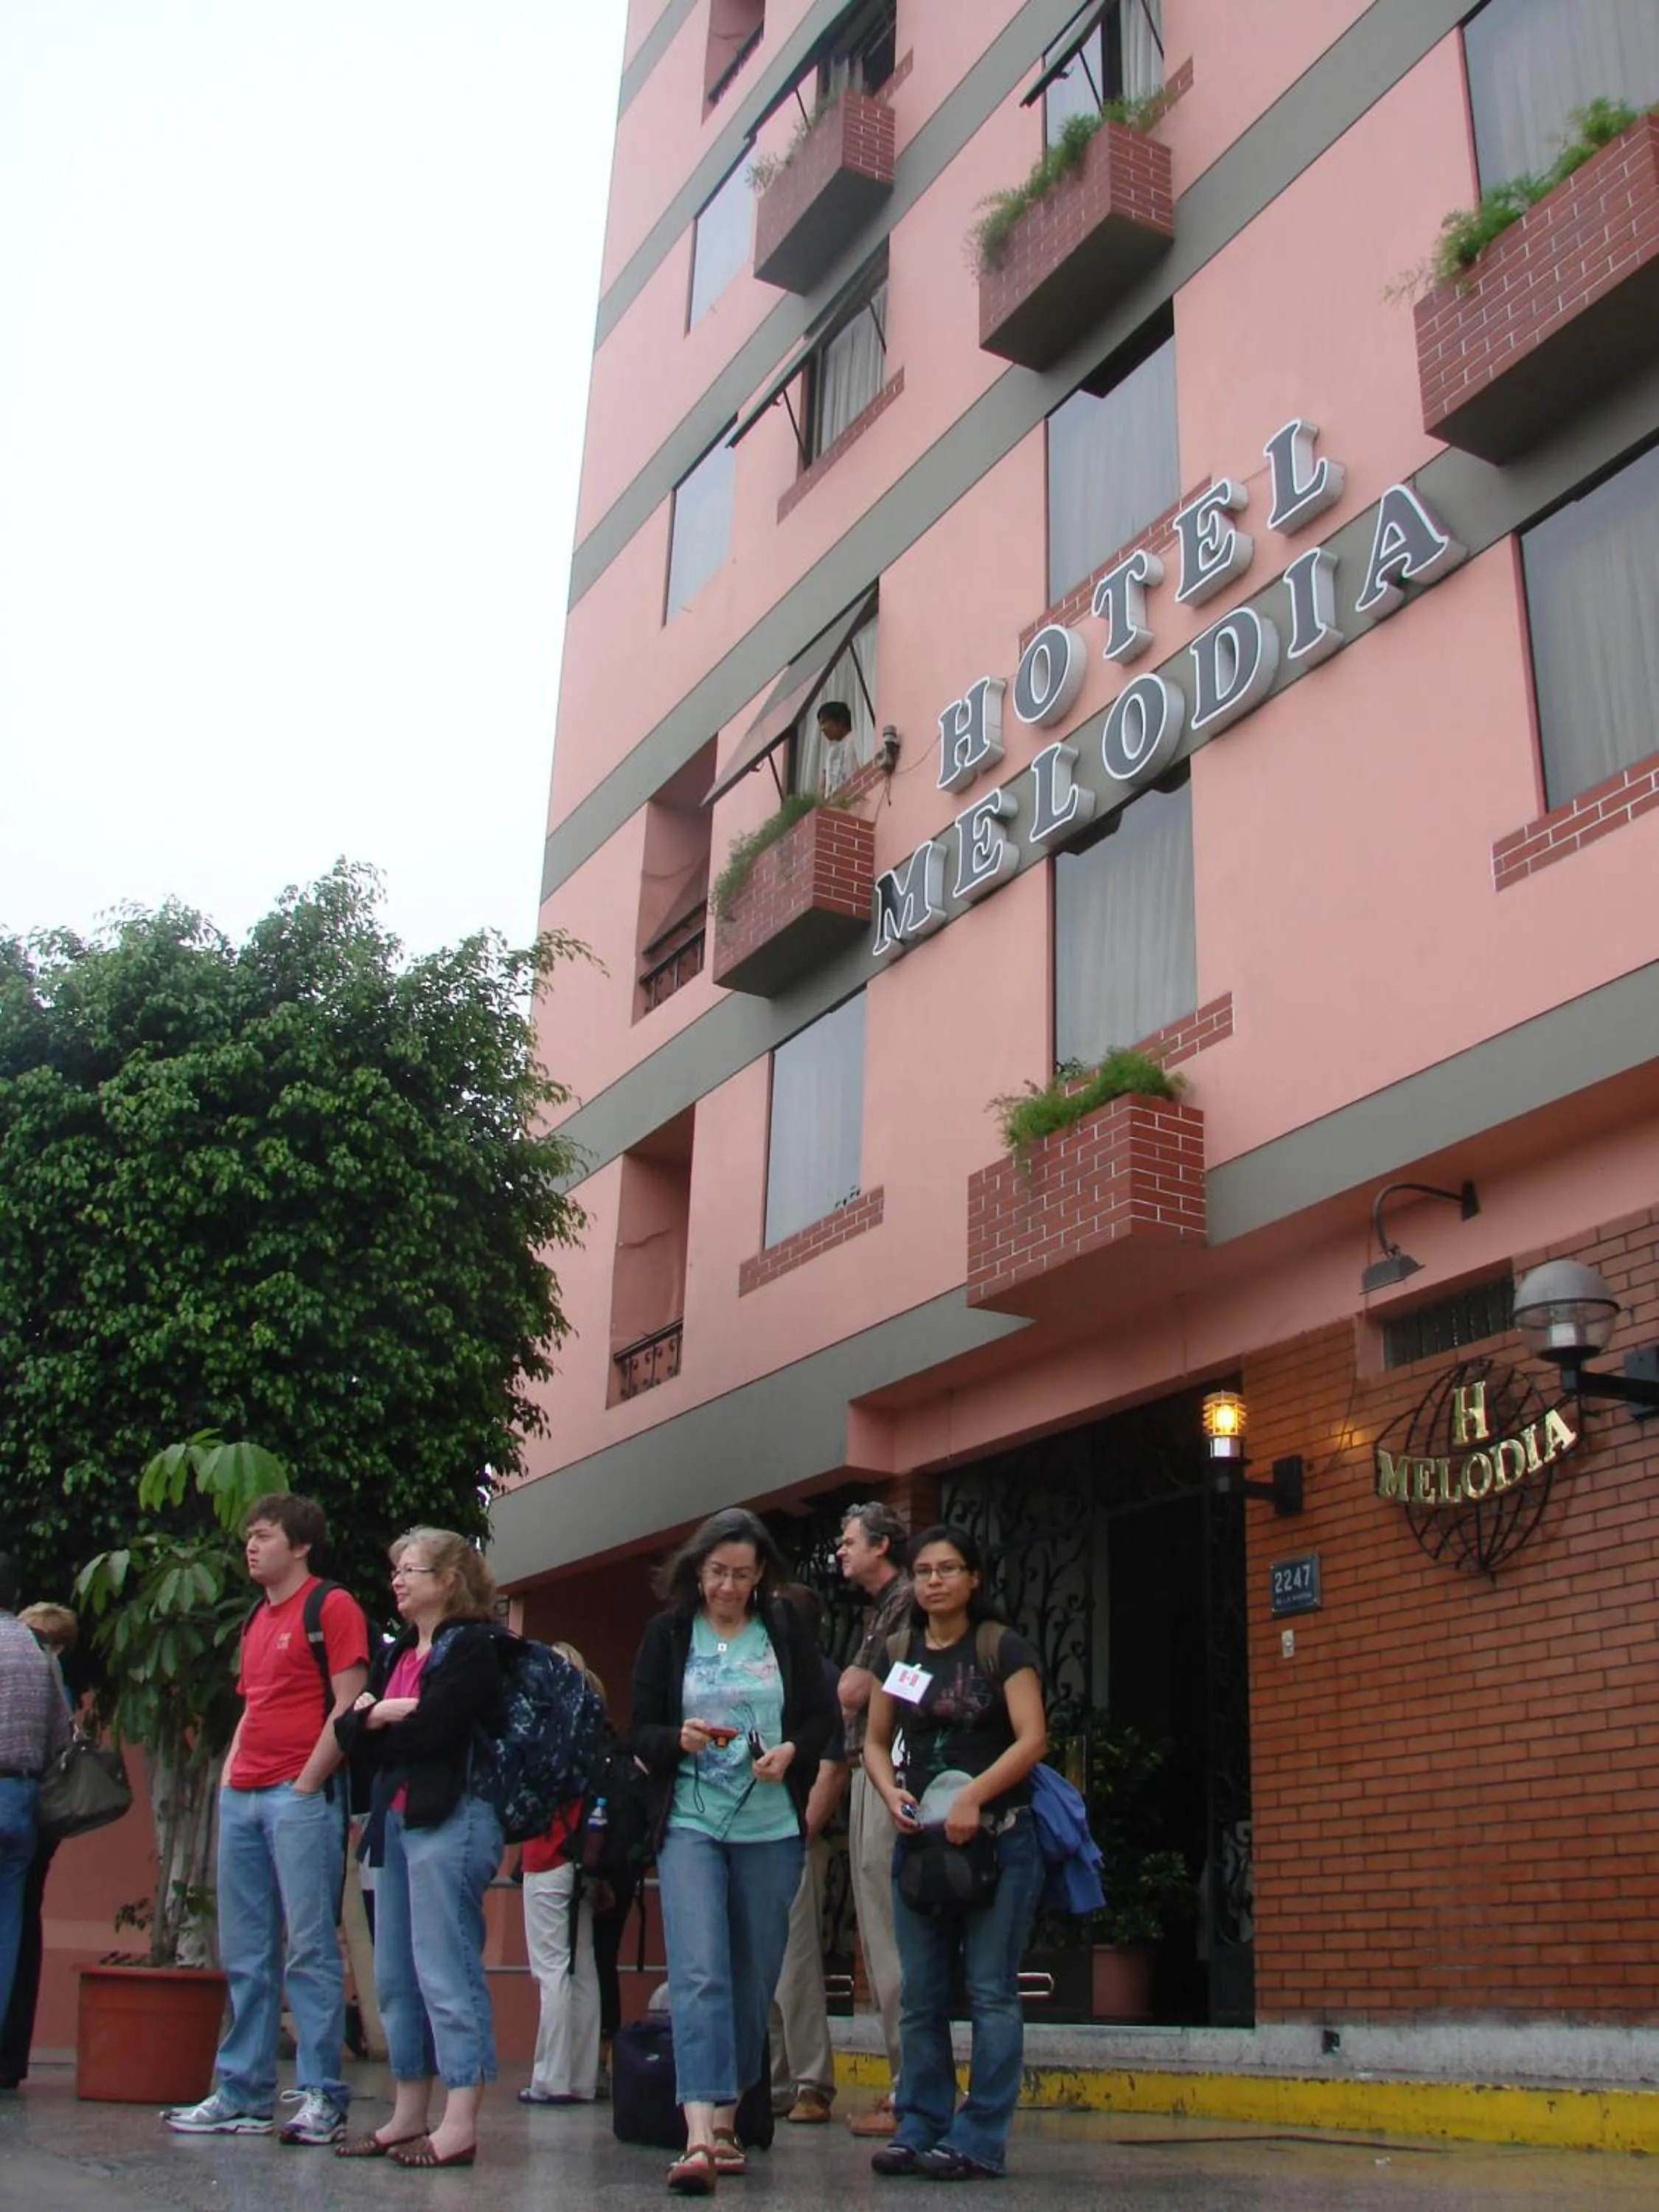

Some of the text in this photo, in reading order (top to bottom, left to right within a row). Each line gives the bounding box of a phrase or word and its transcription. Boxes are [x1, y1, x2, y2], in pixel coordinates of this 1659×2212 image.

[937, 418, 1343, 792] HOTEL
[873, 484, 1466, 957] MELODIA
[1376, 1408, 1578, 1504] MELODIA
[1453, 1380, 1490, 1445] H
[1275, 1564, 1311, 1593] 2247
